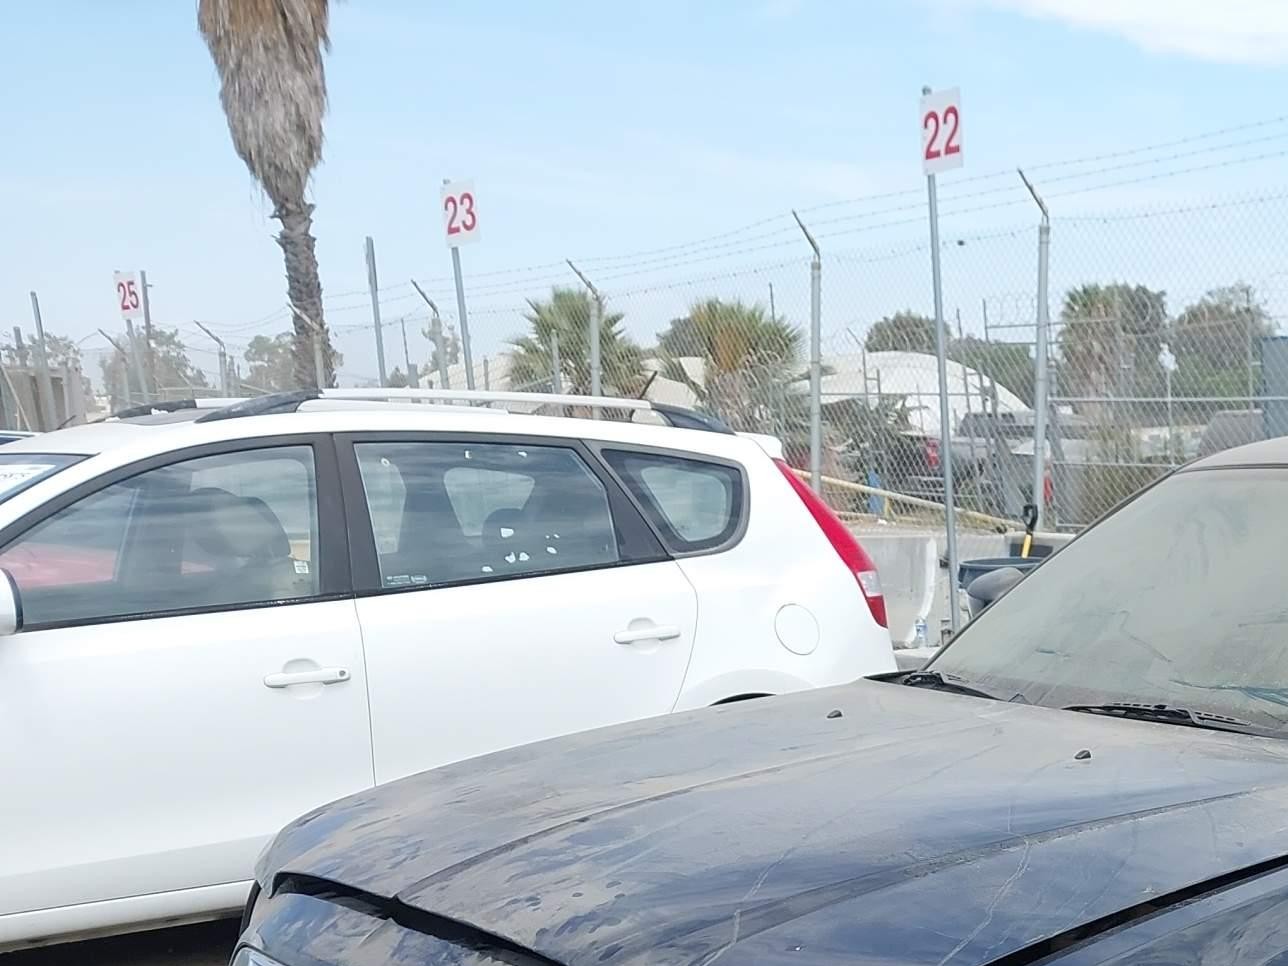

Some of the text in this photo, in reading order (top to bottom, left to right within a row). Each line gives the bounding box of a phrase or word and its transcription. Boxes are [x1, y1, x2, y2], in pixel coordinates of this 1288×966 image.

[924, 105, 960, 160] 22
[443, 191, 477, 236] 23
[116, 279, 140, 311] 25
